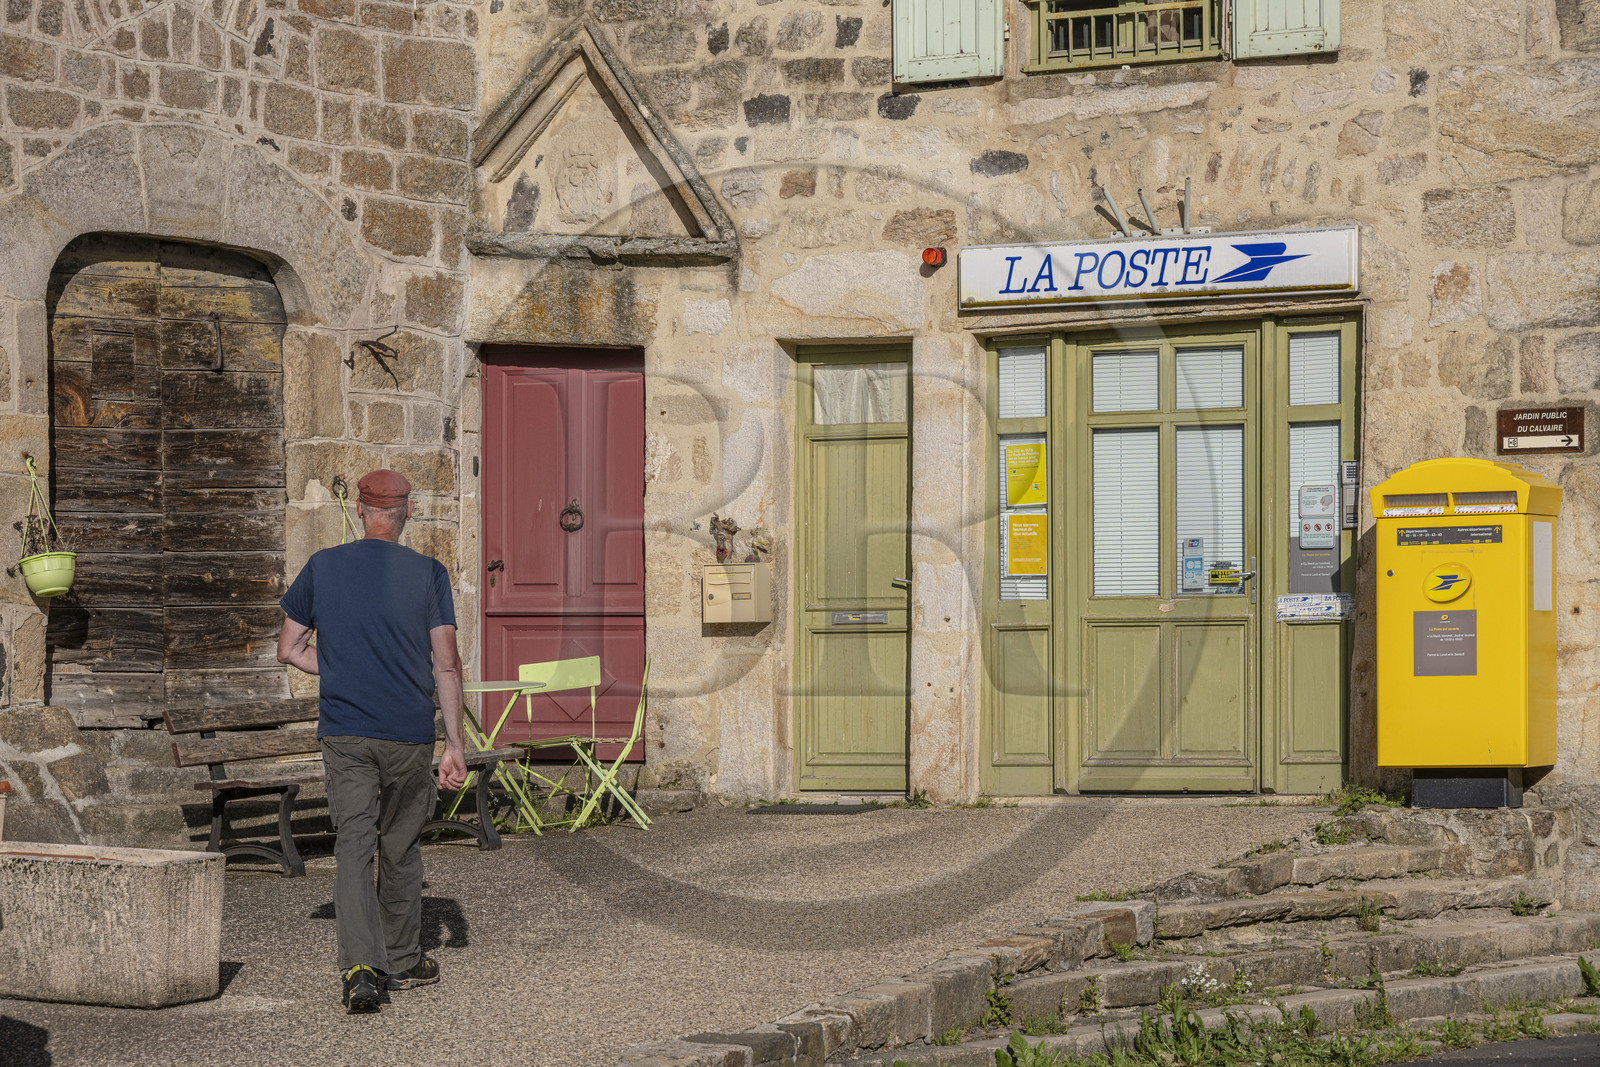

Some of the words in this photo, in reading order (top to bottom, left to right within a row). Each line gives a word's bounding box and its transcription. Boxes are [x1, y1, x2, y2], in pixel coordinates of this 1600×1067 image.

[998, 256, 1059, 294] LA
[1068, 245, 1212, 291] POSTE
[1513, 413, 1540, 421] JARDIN
[1541, 411, 1568, 420] PUBLIC
[1517, 425, 1528, 433] DU
[1529, 424, 1564, 432] CALVAIRE
